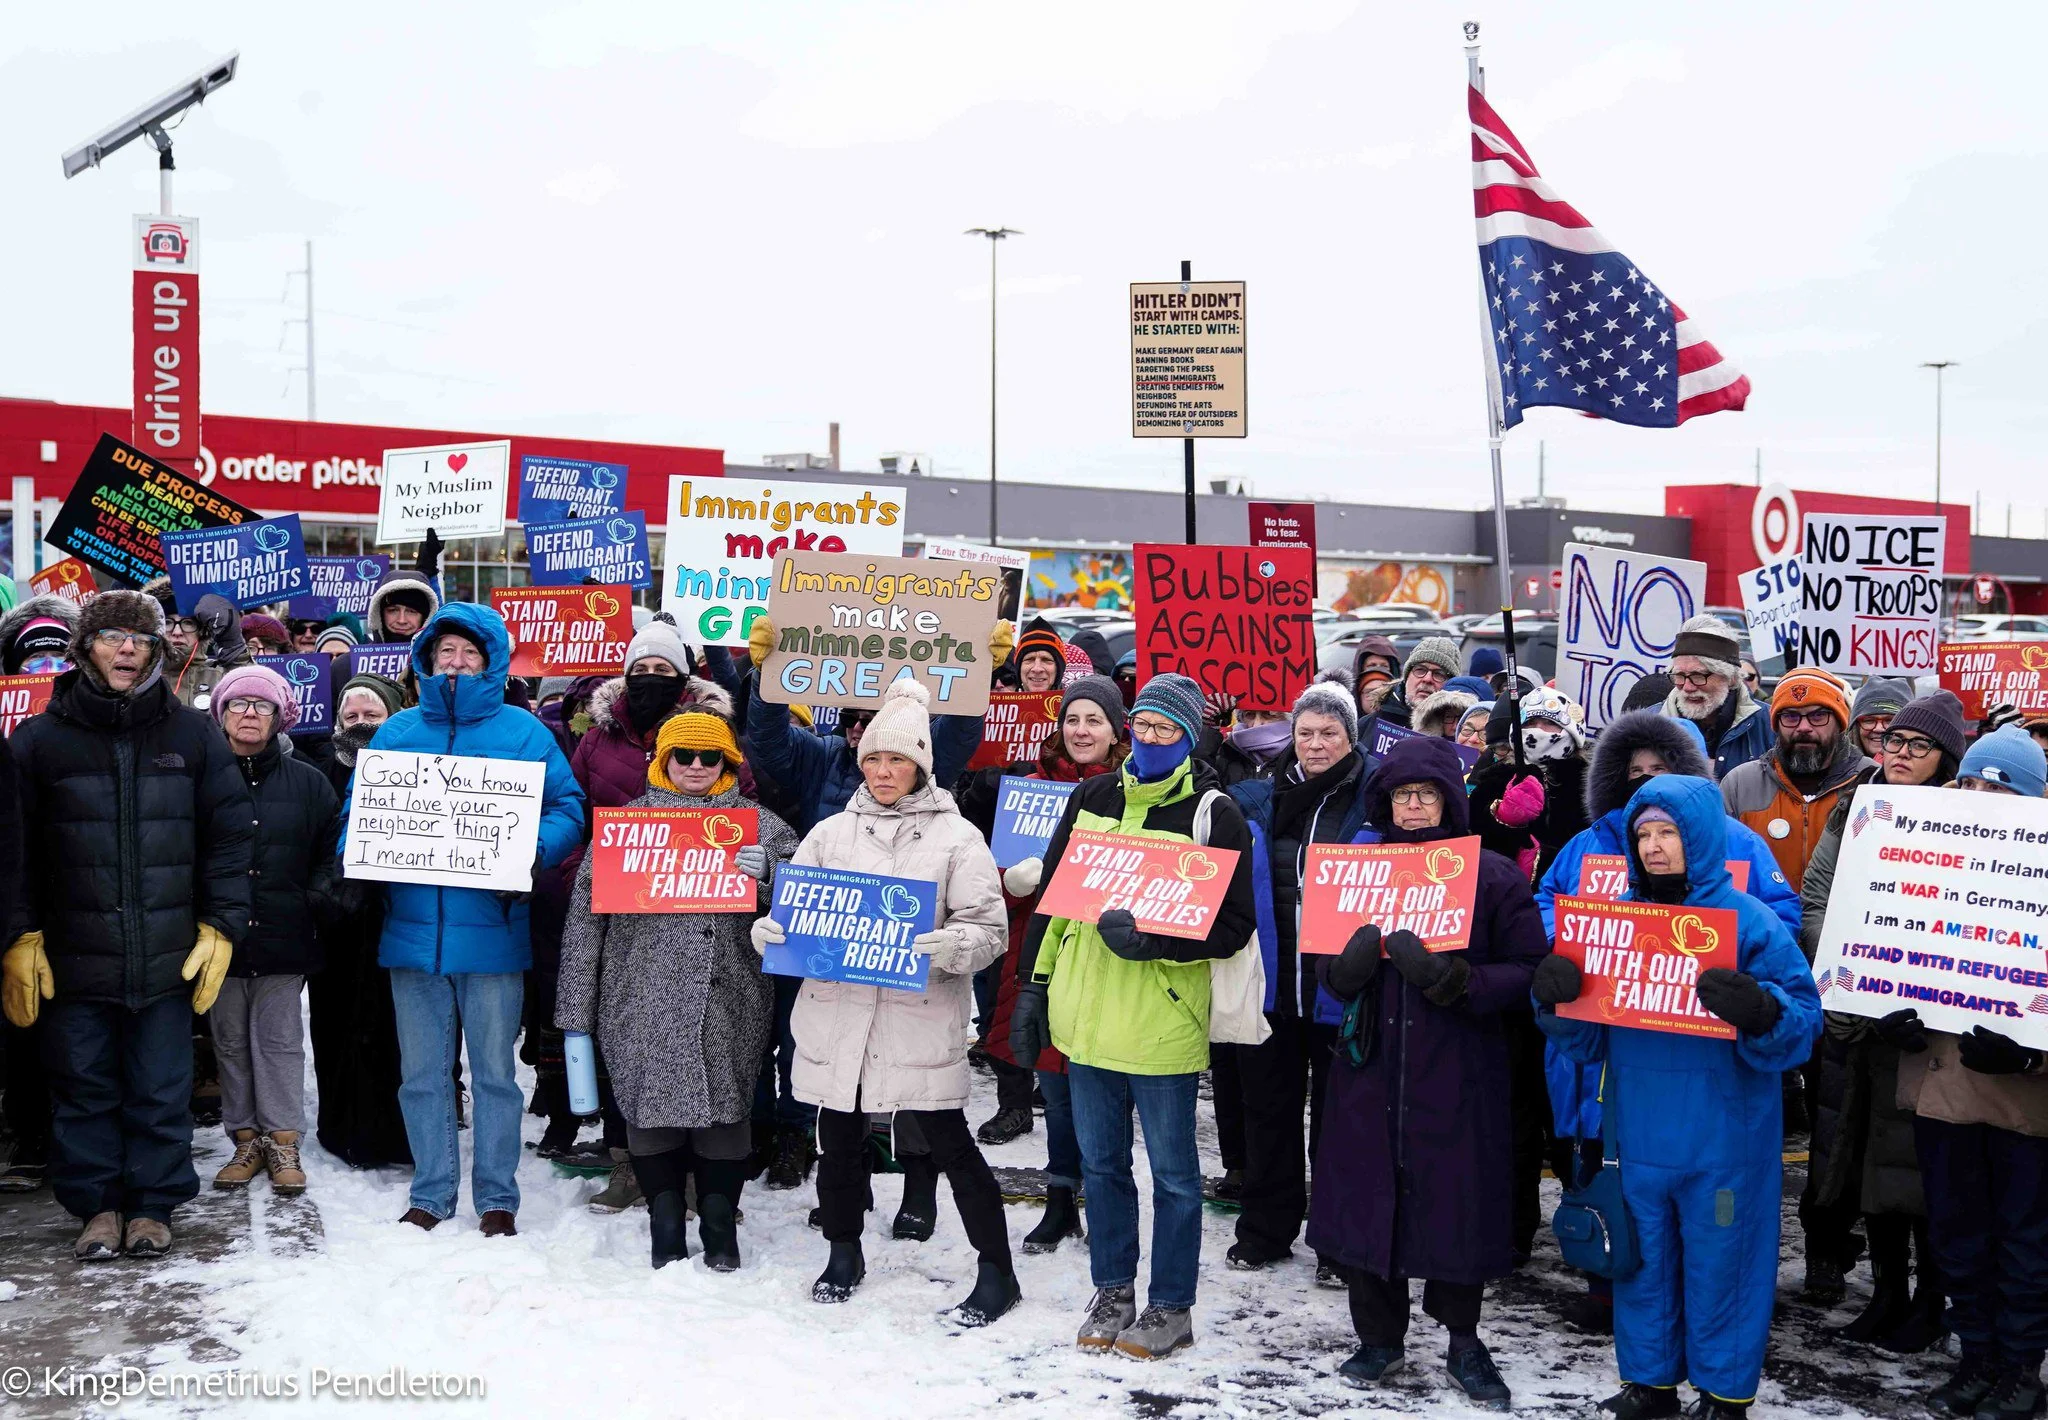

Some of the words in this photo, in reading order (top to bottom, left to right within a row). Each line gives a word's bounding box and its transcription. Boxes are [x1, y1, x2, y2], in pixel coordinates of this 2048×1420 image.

[153, 280, 188, 332] up
[1134, 294, 1187, 309] HITLER
[1191, 293, 1242, 308] DIDN'T
[1134, 311, 1168, 322] START
[1170, 310, 1198, 321] WITH
[1201, 310, 1242, 321] CAMPS.
[1134, 324, 1149, 335] HE
[1152, 324, 1203, 335] STARTED
[1206, 324, 1240, 334] WITH:
[1135, 347, 1157, 355] MAKE
[1158, 347, 1194, 355] GERMANY
[145, 346, 180, 447] drive
[222, 453, 307, 482] order
[424, 460, 429, 473] I
[526, 466, 580, 485] DEFEND
[111, 448, 155, 478] DUE
[155, 470, 243, 526] PROCESS
[141, 480, 195, 514] MEANS
[395, 483, 422, 501] My
[427, 478, 493, 496] Muslim
[532, 483, 614, 505] IMMIGRANT
[91, 495, 117, 514] CAN
[118, 510, 136, 524] BE
[123, 484, 146, 501] NO
[148, 497, 178, 520] ONE
[181, 515, 203, 530] ON
[401, 502, 484, 520] Neighbor
[680, 481, 900, 532] Immigrants
[95, 526, 118, 545] OR
[97, 513, 131, 539] LIFE,
[185, 532, 204, 540] WITH
[205, 526, 252, 538] IMMIGRANTS
[528, 524, 546, 532] STAND
[548, 523, 564, 531] WITH
[565, 518, 605, 528] IMMIGRANTS
[1264, 517, 1276, 527] No
[1278, 518, 1300, 527] hate.
[1266, 528, 1278, 537] No
[1280, 528, 1300, 537] fear.
[67, 536, 82, 549] TO
[83, 544, 127, 573] DEFEND
[74, 527, 129, 560] WITHOUT
[131, 558, 153, 577] THE
[171, 539, 238, 565] DEFEND
[534, 529, 593, 554] DEFEND
[959, 548, 977, 560] Thy
[1806, 523, 1850, 564] NO
[1855, 526, 1939, 566] ICE
[185, 550, 289, 585] IMMIGRANT
[545, 542, 635, 571] IMMIGRANT
[237, 568, 301, 600] RIGHTS
[539, 589, 584, 597] IMMIGRANTS
[779, 558, 998, 604] Immigrants
[1146, 551, 1311, 607] Bubbies
[1566, 553, 1694, 659] NO
[1802, 572, 1842, 612] NO
[1845, 574, 1942, 616] TROOPS
[500, 600, 557, 622] STAND
[830, 603, 942, 634] make
[519, 622, 564, 643] WITH
[569, 620, 606, 642] OUR
[1147, 608, 1313, 656] AGAINST
[543, 641, 627, 664] FAMILIES
[1800, 626, 1841, 666] NO
[1850, 624, 1936, 669] KINGS!
[1943, 653, 1997, 674] STAND
[1960, 672, 2002, 691] WITH
[2006, 671, 2041, 690] OUR
[362, 755, 429, 787] God:
[482, 765, 528, 793] know
[361, 788, 396, 807] that
[405, 791, 442, 812] love
[450, 800, 497, 819] your
[358, 817, 440, 840] neighbor
[600, 823, 670, 847] STAND
[1895, 815, 1918, 834] My
[1922, 820, 2008, 841] ancestors
[2013, 827, 2048, 845] fled
[356, 840, 371, 864] I
[377, 848, 434, 867] meant
[623, 849, 677, 873] WITH
[683, 849, 726, 873] OUR
[1069, 843, 1145, 872] STAND
[1879, 846, 1965, 869] GENOCIDE
[1970, 858, 1985, 871] in
[650, 874, 748, 898] FAMILIES
[1081, 869, 1142, 895] WITH
[1143, 877, 1194, 903] OUR
[1315, 860, 1392, 886] STAND
[779, 881, 863, 914] DEFEND
[1337, 887, 1398, 913] WITH
[1402, 884, 1447, 911] OUR
[1870, 880, 1895, 893] and
[1901, 882, 1939, 899] WAR
[1944, 888, 1959, 901] in
[788, 908, 914, 947] IMMIGRANT
[1561, 913, 1634, 947] STAND
[1865, 911, 1870, 924] I
[1874, 915, 1899, 927] am
[1904, 919, 1926, 932] an
[1931, 920, 2043, 950] AMERICAN.
[842, 941, 922, 976] RIGHTS
[1584, 945, 1644, 980] WITH
[1648, 953, 1699, 985] OUR
[1842, 943, 1849, 956] I
[1851, 944, 1904, 963] STAND
[1907, 951, 1954, 970] WITH
[1857, 976, 1894, 994] AND
[1897, 982, 2024, 1018] IMMIGRANTS.
